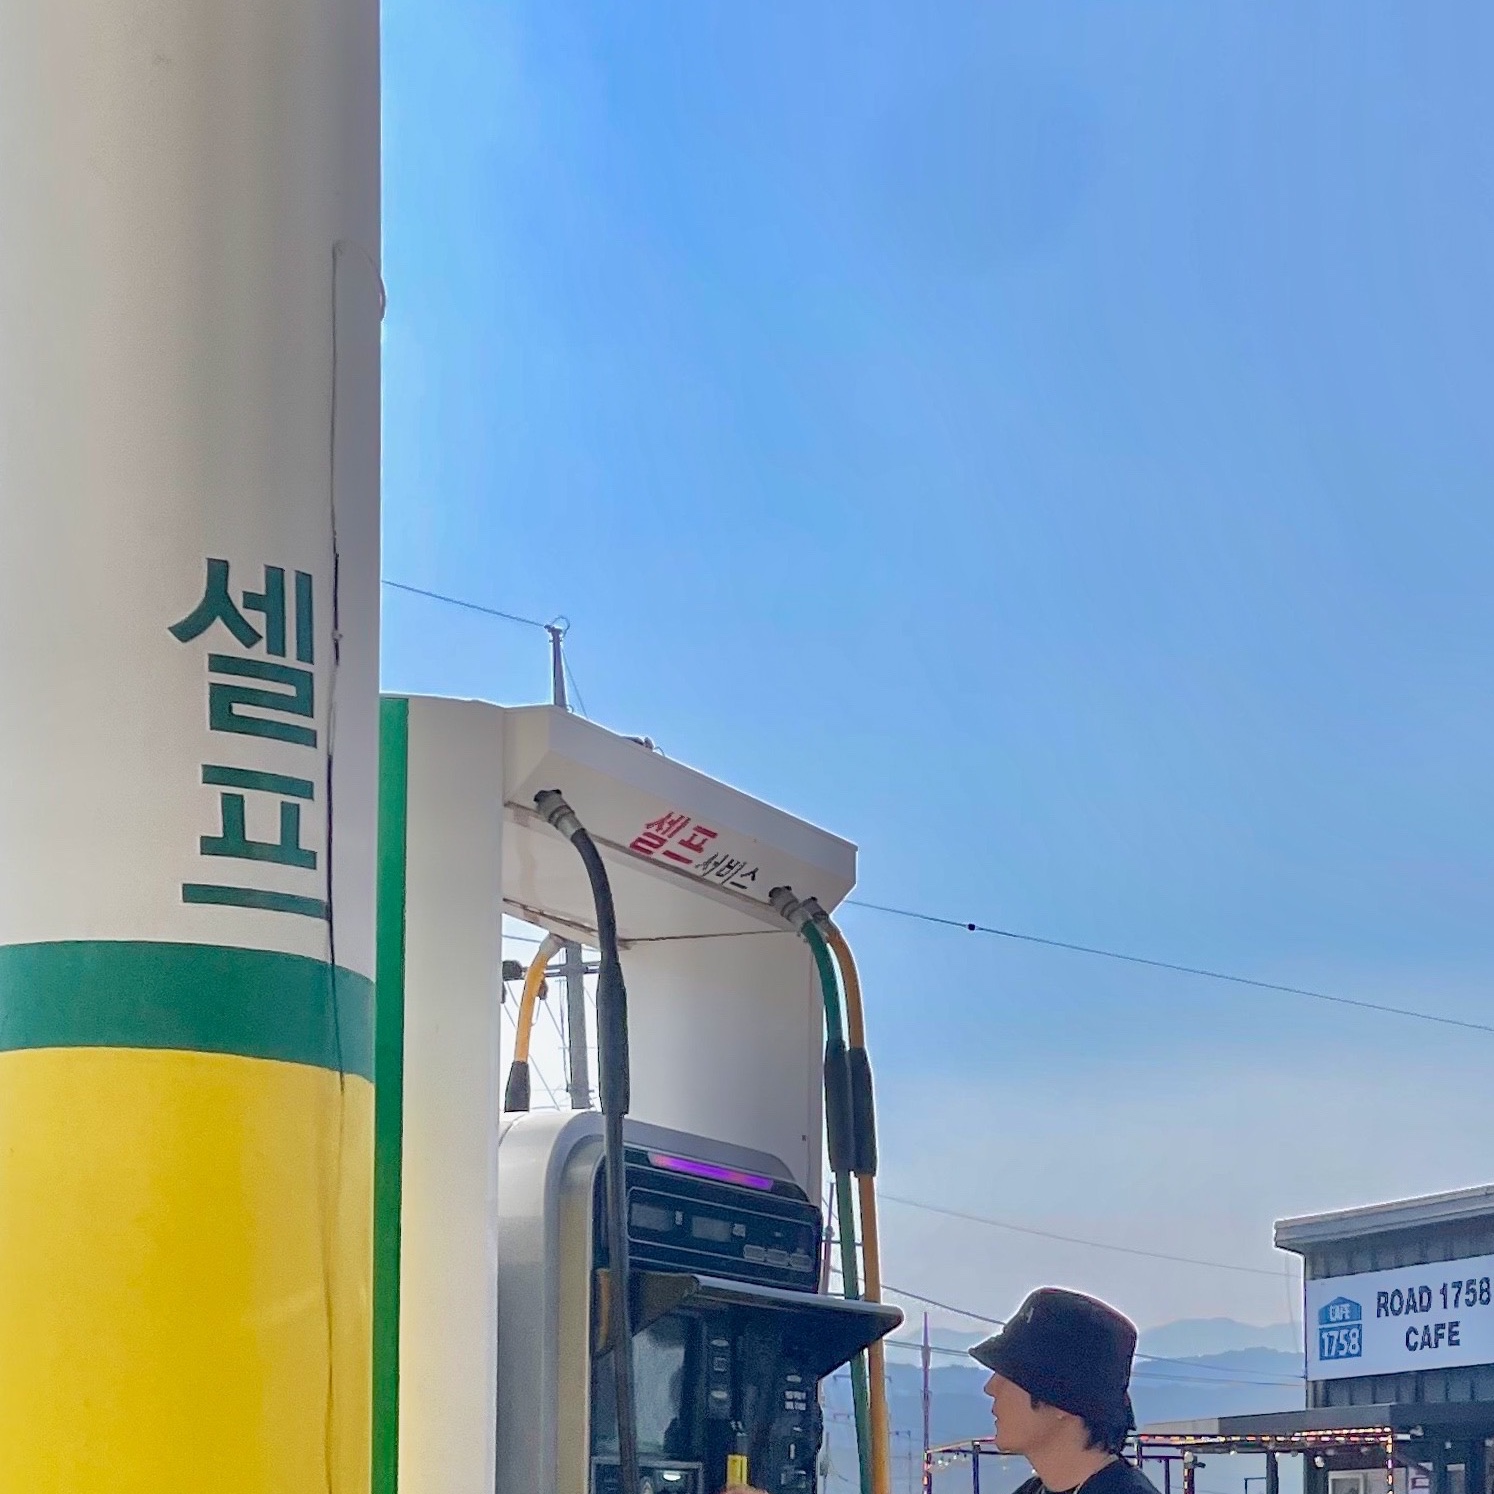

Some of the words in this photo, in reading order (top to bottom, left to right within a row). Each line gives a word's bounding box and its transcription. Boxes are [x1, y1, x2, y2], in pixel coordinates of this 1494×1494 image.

[168, 557, 330, 921] 셀프
[629, 811, 718, 865] 셀프
[695, 852, 759, 889] 서비스
[1329, 1303, 1351, 1321] CAFE
[1376, 1285, 1432, 1318] ROAD
[1440, 1277, 1491, 1309] 1758
[1321, 1328, 1360, 1357] 1758
[1405, 1321, 1461, 1351] CAFE
